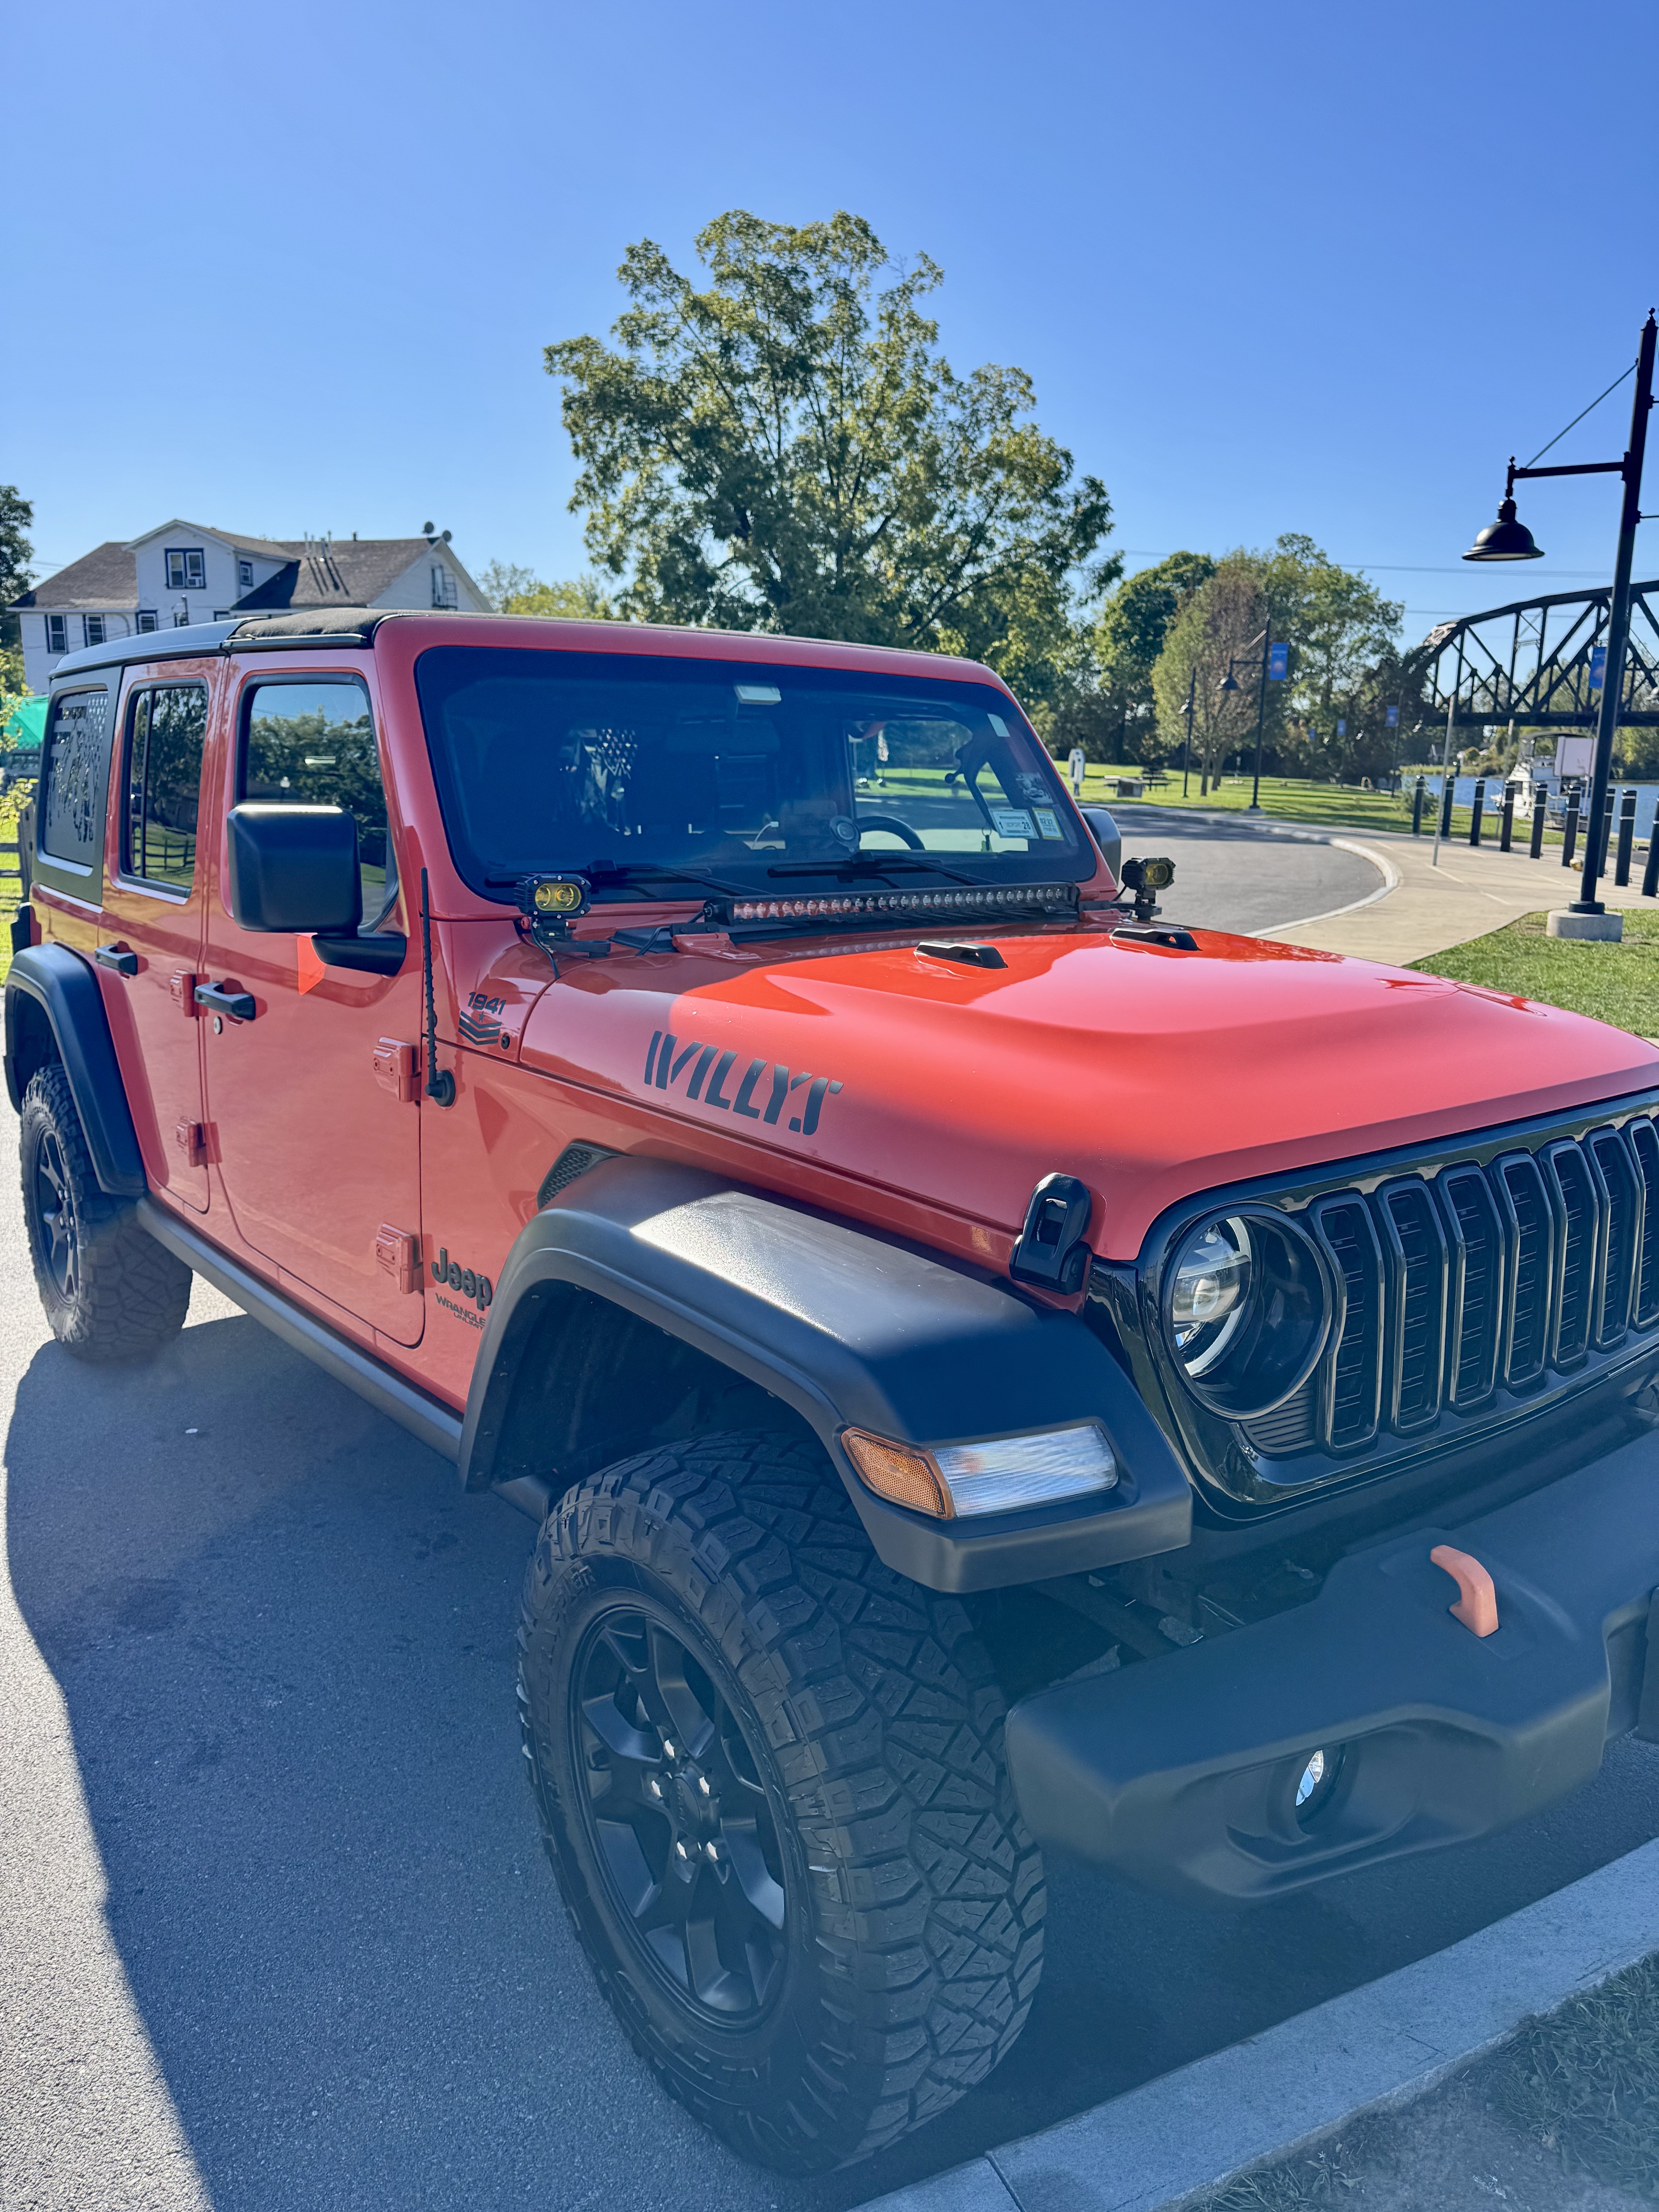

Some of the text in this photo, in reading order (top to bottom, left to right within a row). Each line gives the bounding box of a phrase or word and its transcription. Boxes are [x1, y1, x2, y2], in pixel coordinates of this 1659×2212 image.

[468, 992, 506, 1015] 1941
[644, 1030, 843, 1135] WILLYS
[431, 1247, 492, 1311] Jeep
[435, 1293, 486, 1327] WRANGLE
[453, 1312, 484, 1330] UNLIMIT
